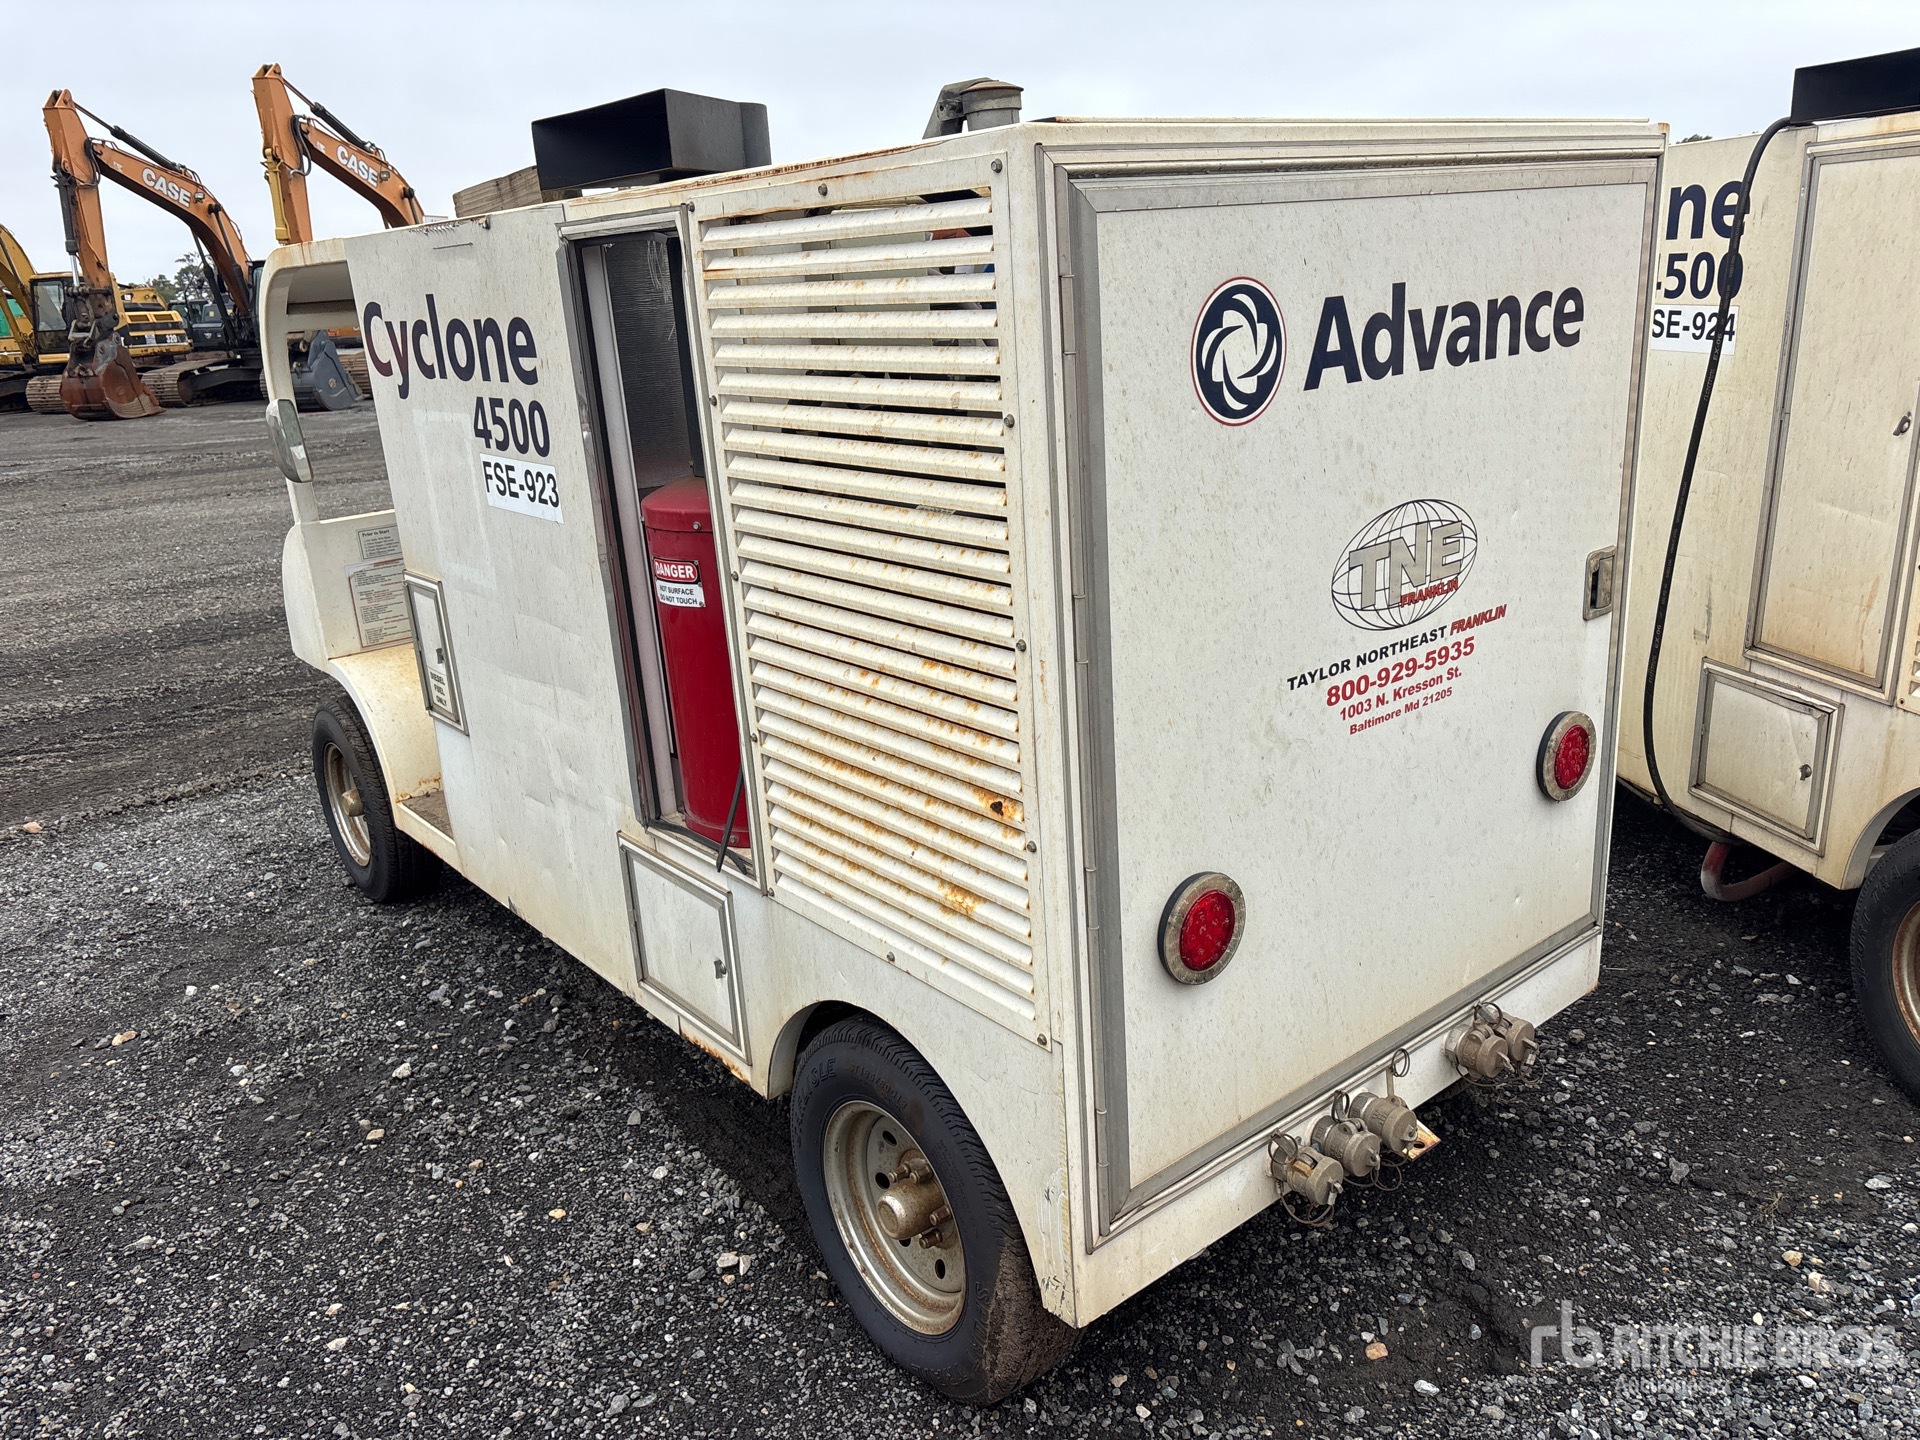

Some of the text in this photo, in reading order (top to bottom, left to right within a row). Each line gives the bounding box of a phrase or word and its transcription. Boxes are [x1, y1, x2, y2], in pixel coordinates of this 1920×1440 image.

[142, 168, 191, 208] CASE
[336, 145, 379, 188] CASE
[1656, 251, 1744, 300] 500
[362, 294, 539, 400] Cyclone
[1303, 282, 1585, 391] Advance
[473, 396, 550, 458] 4500
[482, 460, 559, 508] FSE-923
[655, 562, 694, 578] DANGER
[1348, 520, 1464, 608] TNE
[665, 595, 675, 603] NOT
[676, 597, 698, 605] TOUCH
[667, 586, 694, 596] SURFACE
[1399, 577, 1459, 608] FRANKLIN
[1286, 604, 1507, 691] TAYLOR NORTHEAST FRANKLIN
[1326, 636, 1476, 707] 800-929-5935
[1339, 665, 1463, 722] 1003 N. Kresson St.
[1349, 686, 1453, 736] Baltimore Md 21205
